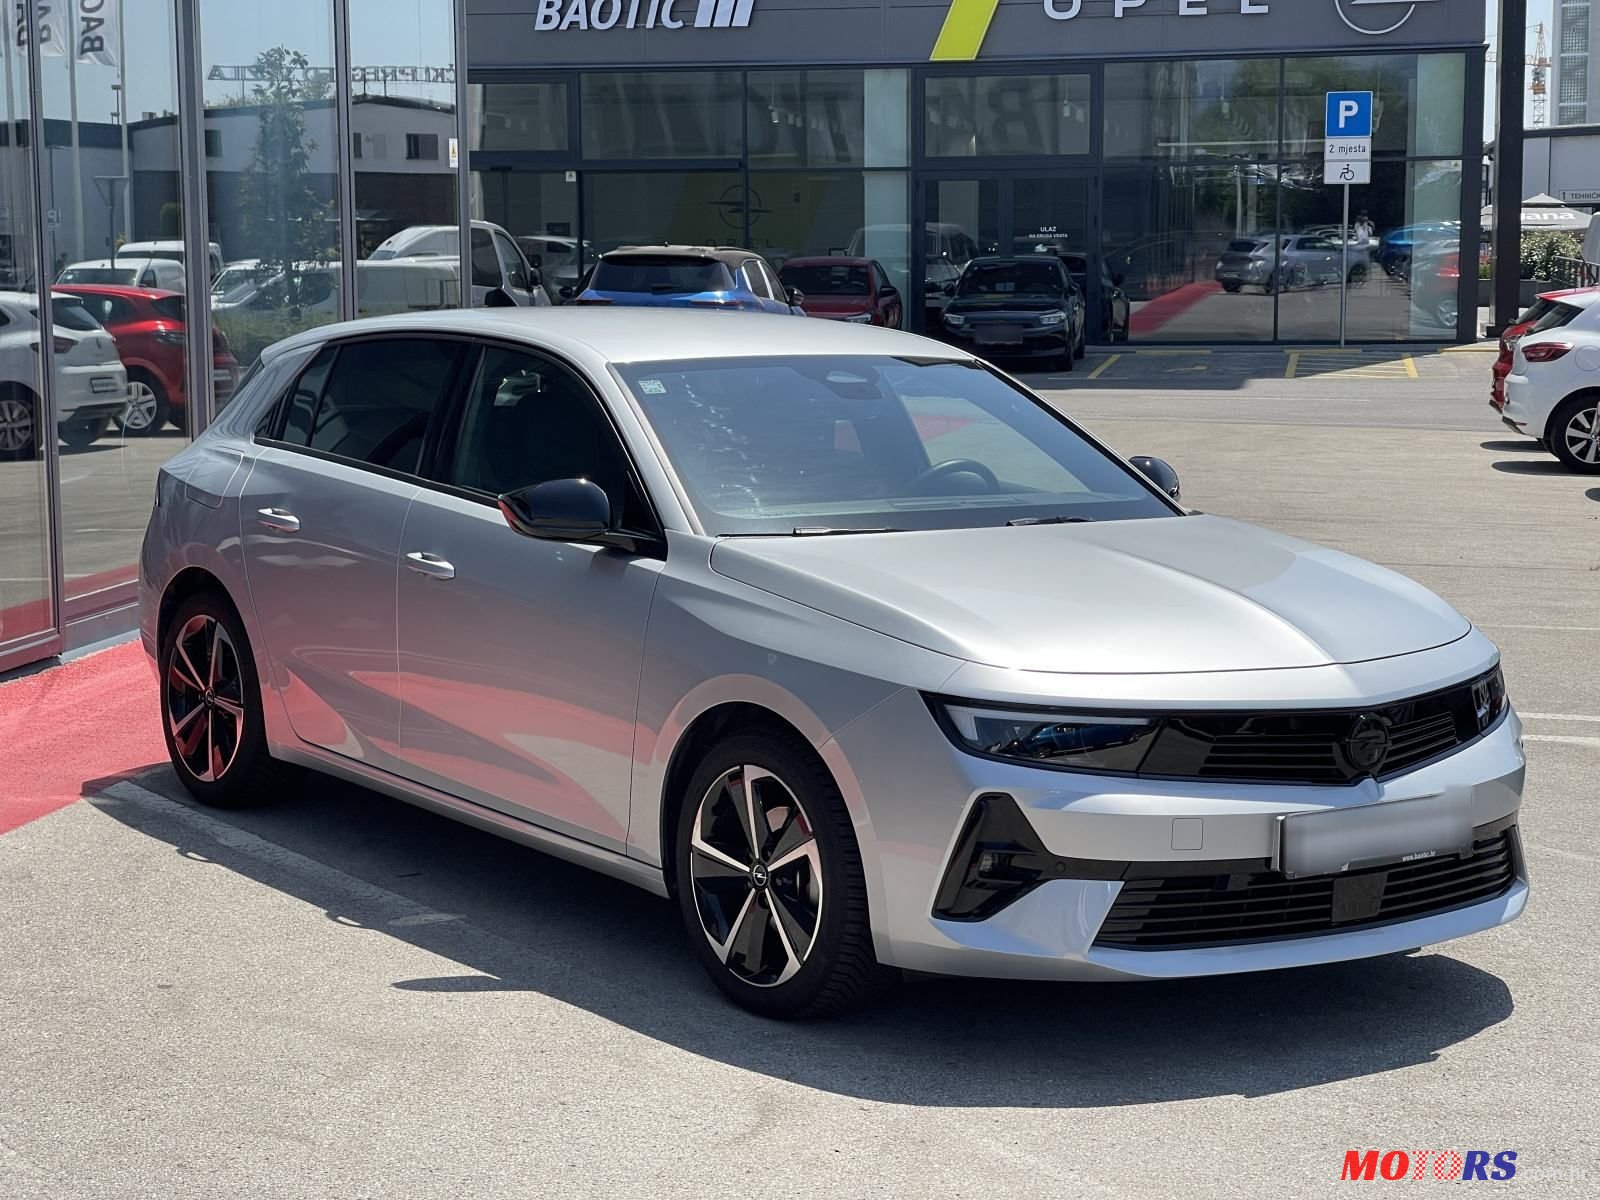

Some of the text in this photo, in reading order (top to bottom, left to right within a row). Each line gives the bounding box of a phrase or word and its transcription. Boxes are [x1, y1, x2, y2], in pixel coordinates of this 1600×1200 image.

[1338, 100, 1359, 129] P
[1328, 144, 1366, 155] 2 mjesta
[1562, 191, 1566, 200] 1
